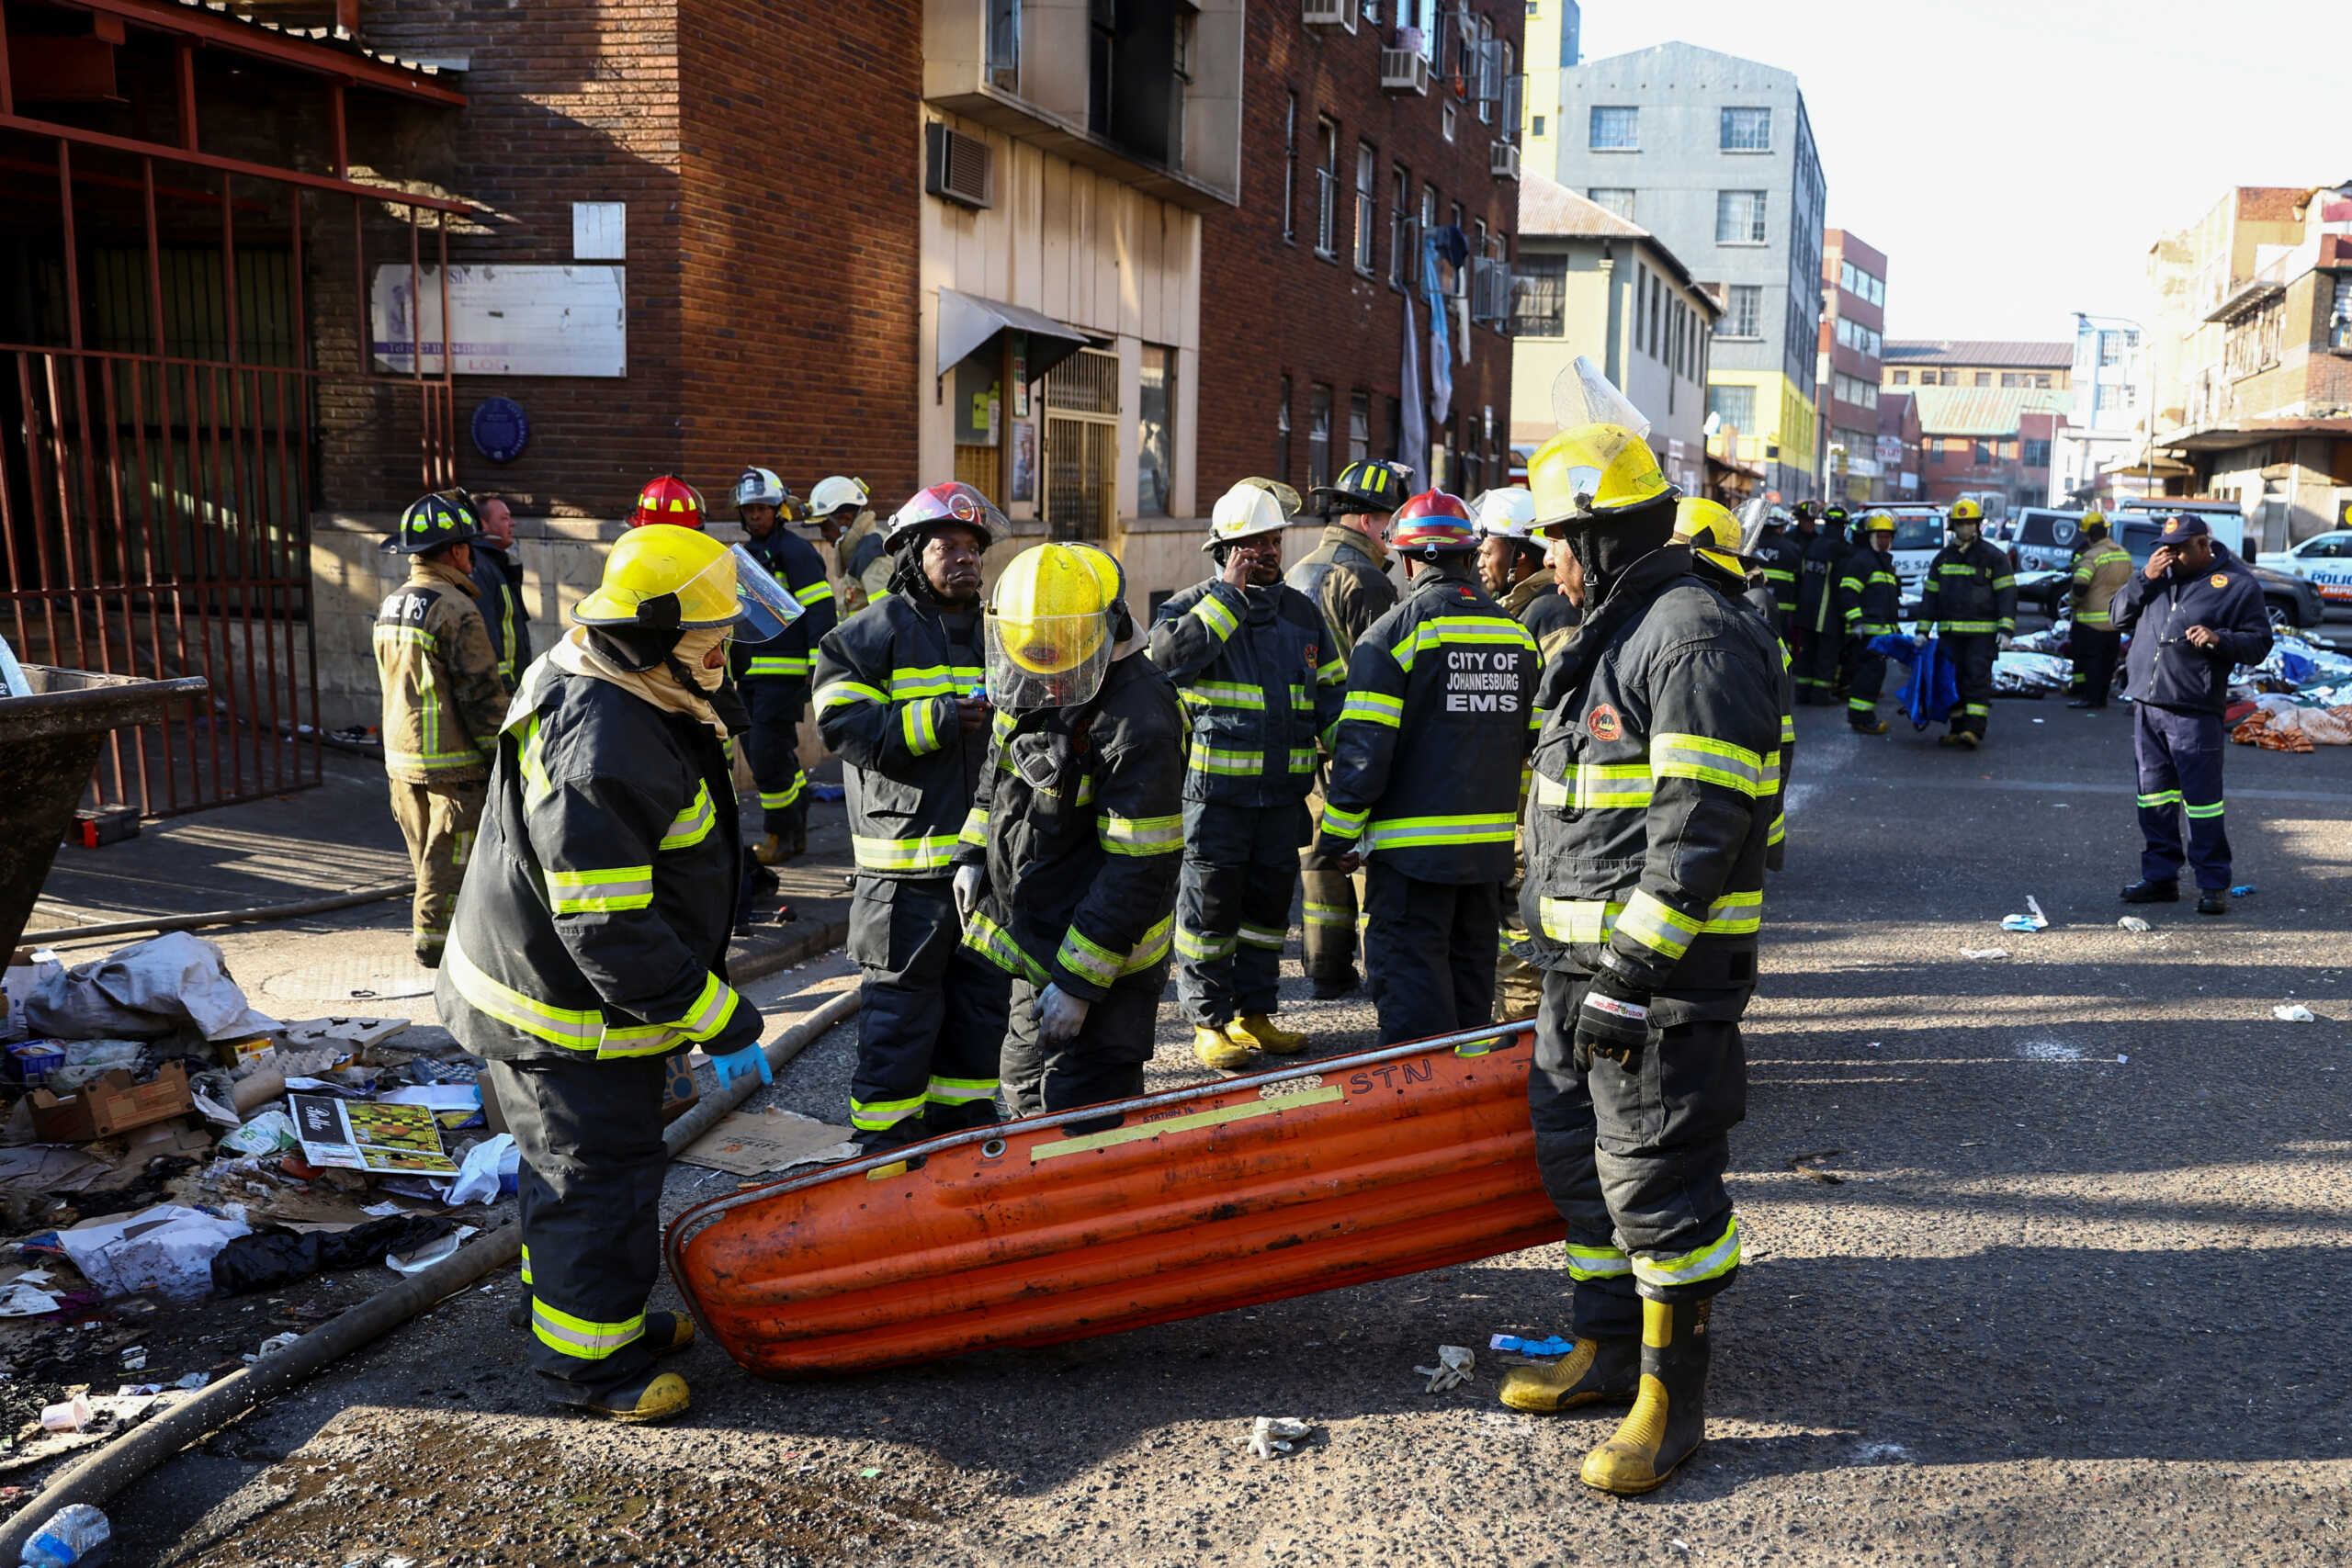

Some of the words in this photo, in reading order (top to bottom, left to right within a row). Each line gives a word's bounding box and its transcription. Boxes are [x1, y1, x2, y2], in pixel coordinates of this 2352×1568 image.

[2020, 544, 2051, 555] FIRE
[2053, 548, 2074, 558] OP
[1893, 560, 1909, 570] PS
[1914, 560, 1930, 570] SA
[2311, 572, 2352, 585] POLIC
[1447, 651, 1488, 671] CITY
[1493, 652, 1519, 671] OF
[1446, 672, 1520, 691] JOHANNESBURG
[1446, 694, 1519, 713] EMS
[1351, 1058, 1432, 1094] STN
[1143, 1111, 1181, 1123] STATION
